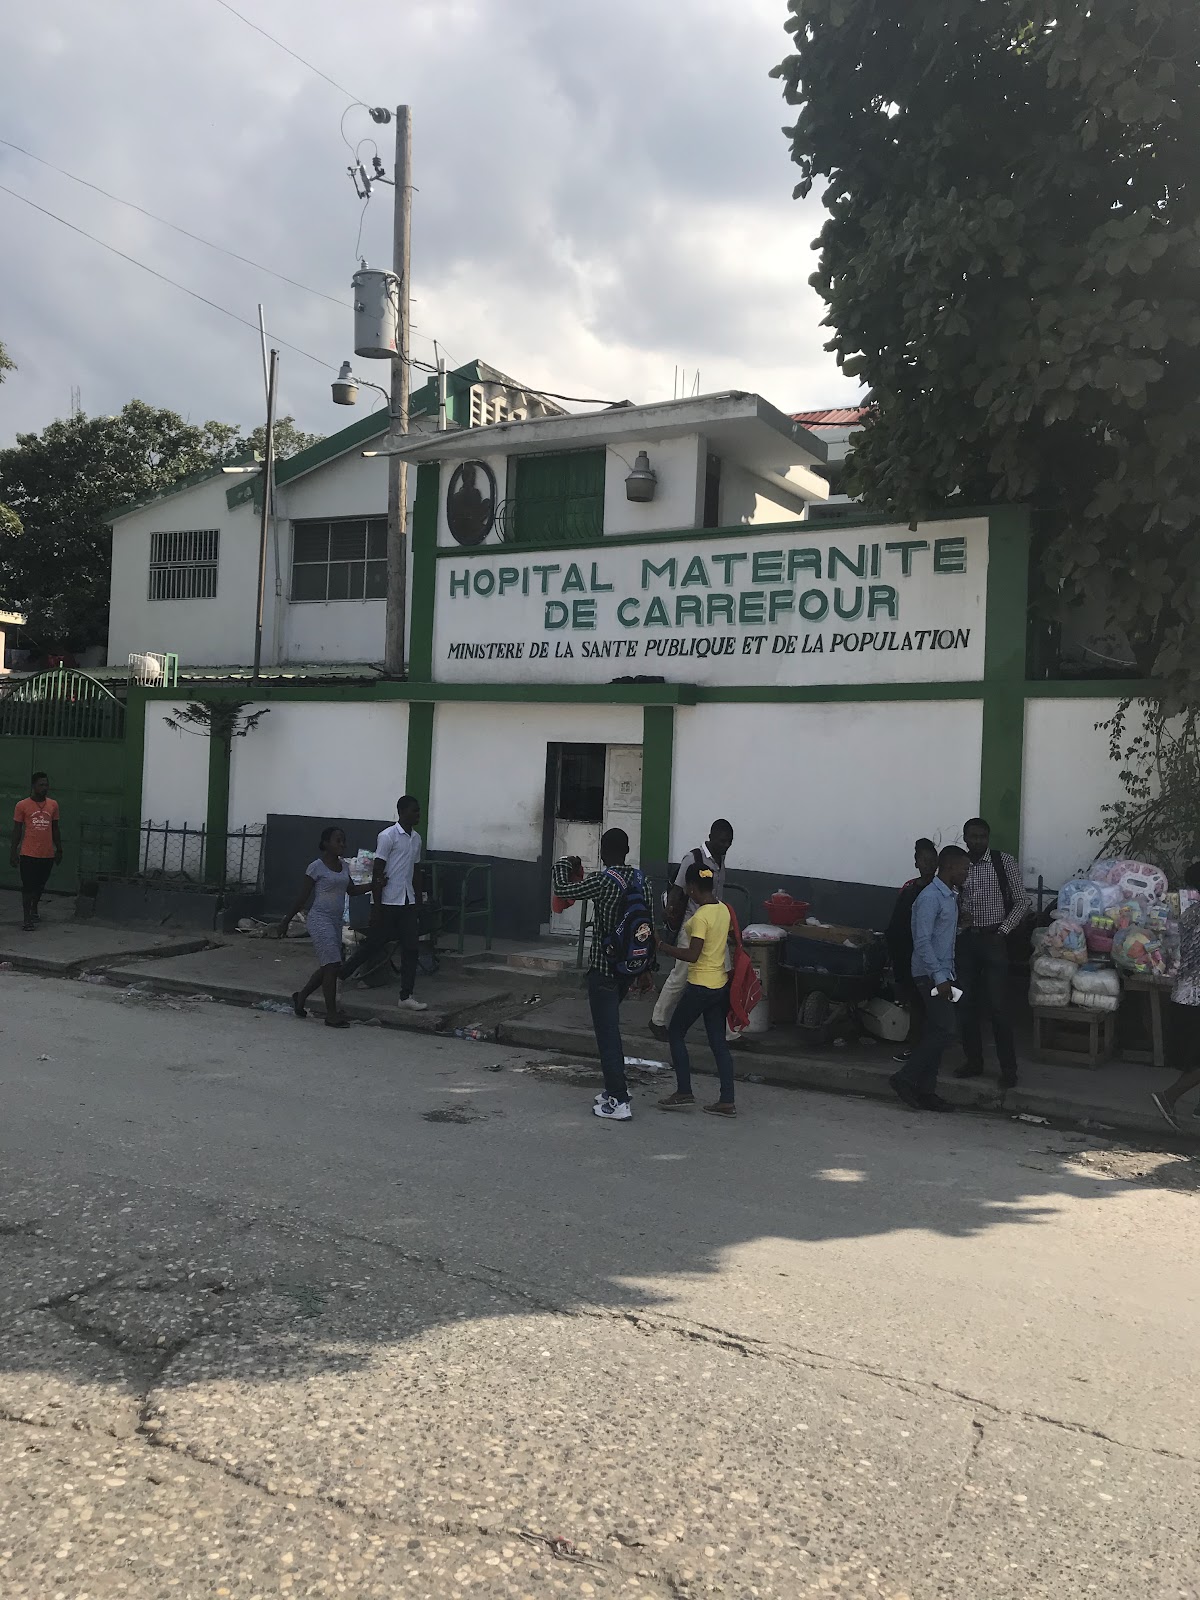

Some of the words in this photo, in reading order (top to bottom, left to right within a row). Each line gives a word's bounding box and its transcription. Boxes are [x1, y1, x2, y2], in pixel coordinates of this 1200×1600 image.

[450, 562, 614, 598] HOPITAL
[641, 537, 967, 589] MATERNITE
[544, 599, 597, 630] DE
[617, 585, 899, 629] CARREFOUR
[447, 642, 525, 660] MINISTERE
[529, 641, 550, 658] DE
[555, 641, 574, 658] LA
[581, 640, 639, 658] SANTE
[644, 636, 736, 658] PUBLIQUE
[741, 635, 768, 655] ET
[771, 635, 798, 654] DE
[801, 633, 824, 653] LA
[829, 628, 971, 653] POPULATION
